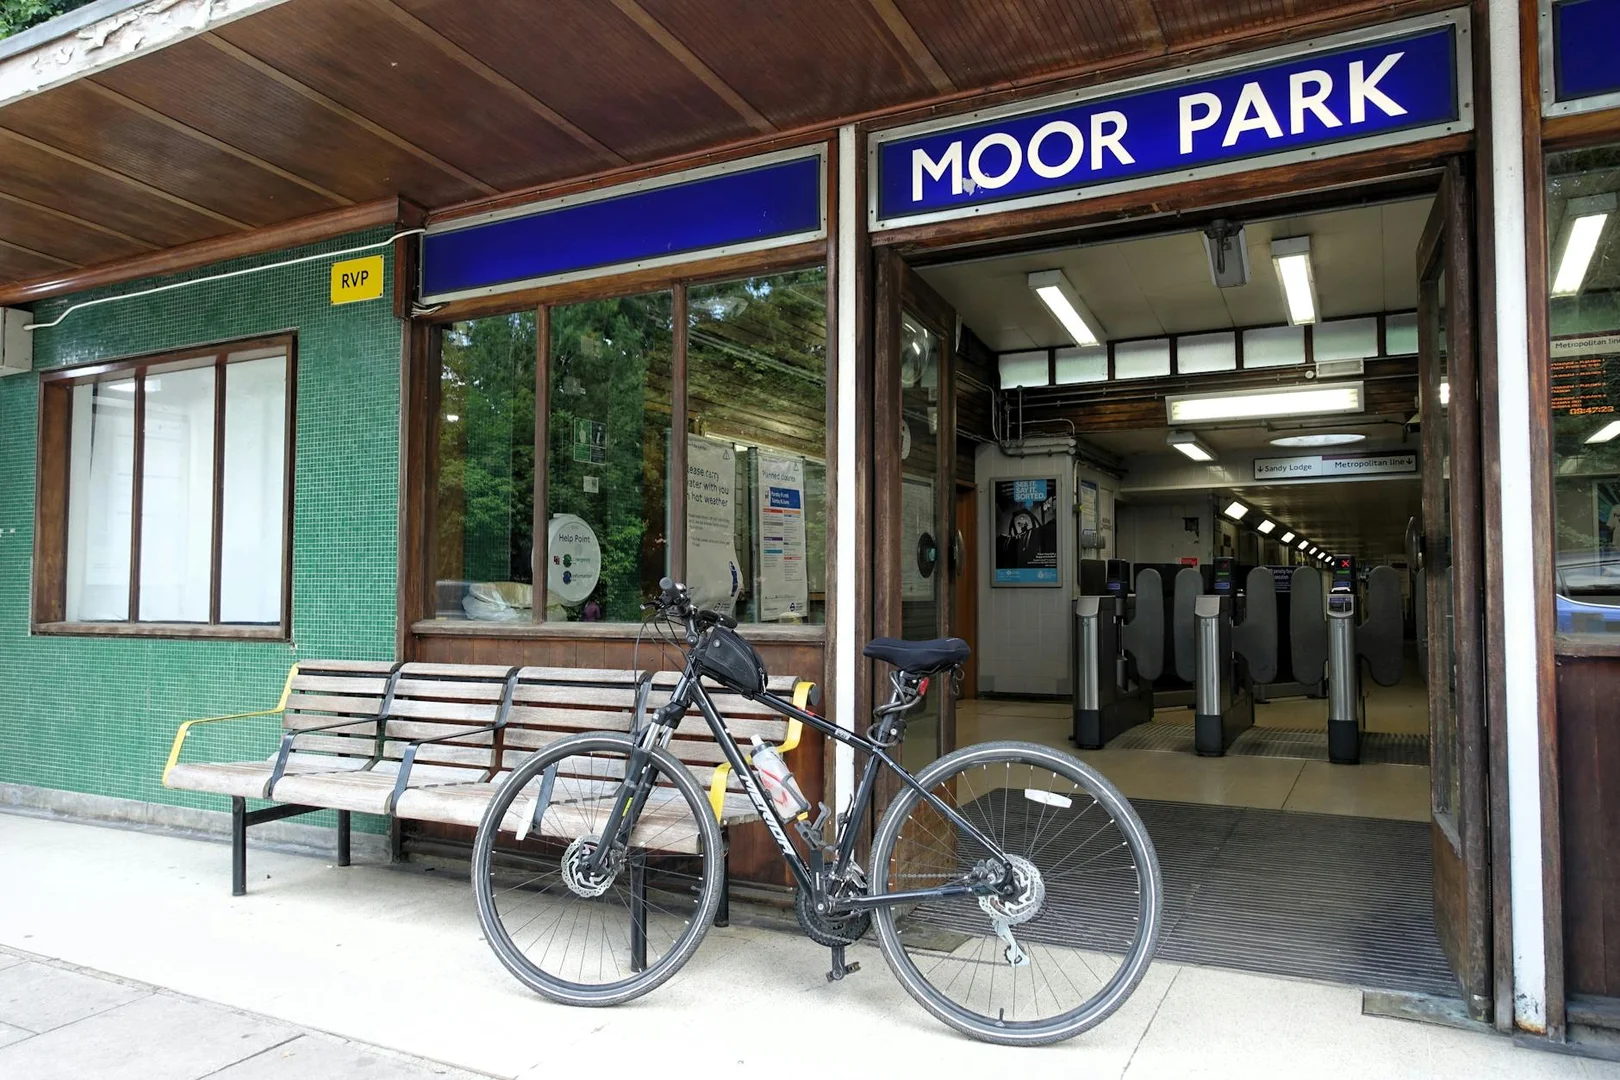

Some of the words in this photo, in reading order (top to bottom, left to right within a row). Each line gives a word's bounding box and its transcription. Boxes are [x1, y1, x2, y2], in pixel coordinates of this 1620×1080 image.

[911, 110, 1135, 201] MOOR
[1179, 52, 1408, 155] PARK
[341, 270, 369, 289] RVP
[1555, 339, 1607, 349] Metropolitan
[1264, 465, 1287, 473] Sandy
[1289, 463, 1313, 471] Lodge
[1334, 460, 1388, 469] Metropolitan
[1390, 457, 1405, 466] line
[687, 466, 704, 477] lease
[705, 469, 719, 482] carry
[688, 480, 702, 489] ater
[703, 482, 717, 493] with
[718, 486, 729, 496] you
[691, 492, 703, 503] hot
[704, 496, 728, 507] weather
[558, 534, 573, 544] Help
[574, 534, 591, 543] Point
[739, 774, 796, 857] MERIDA
